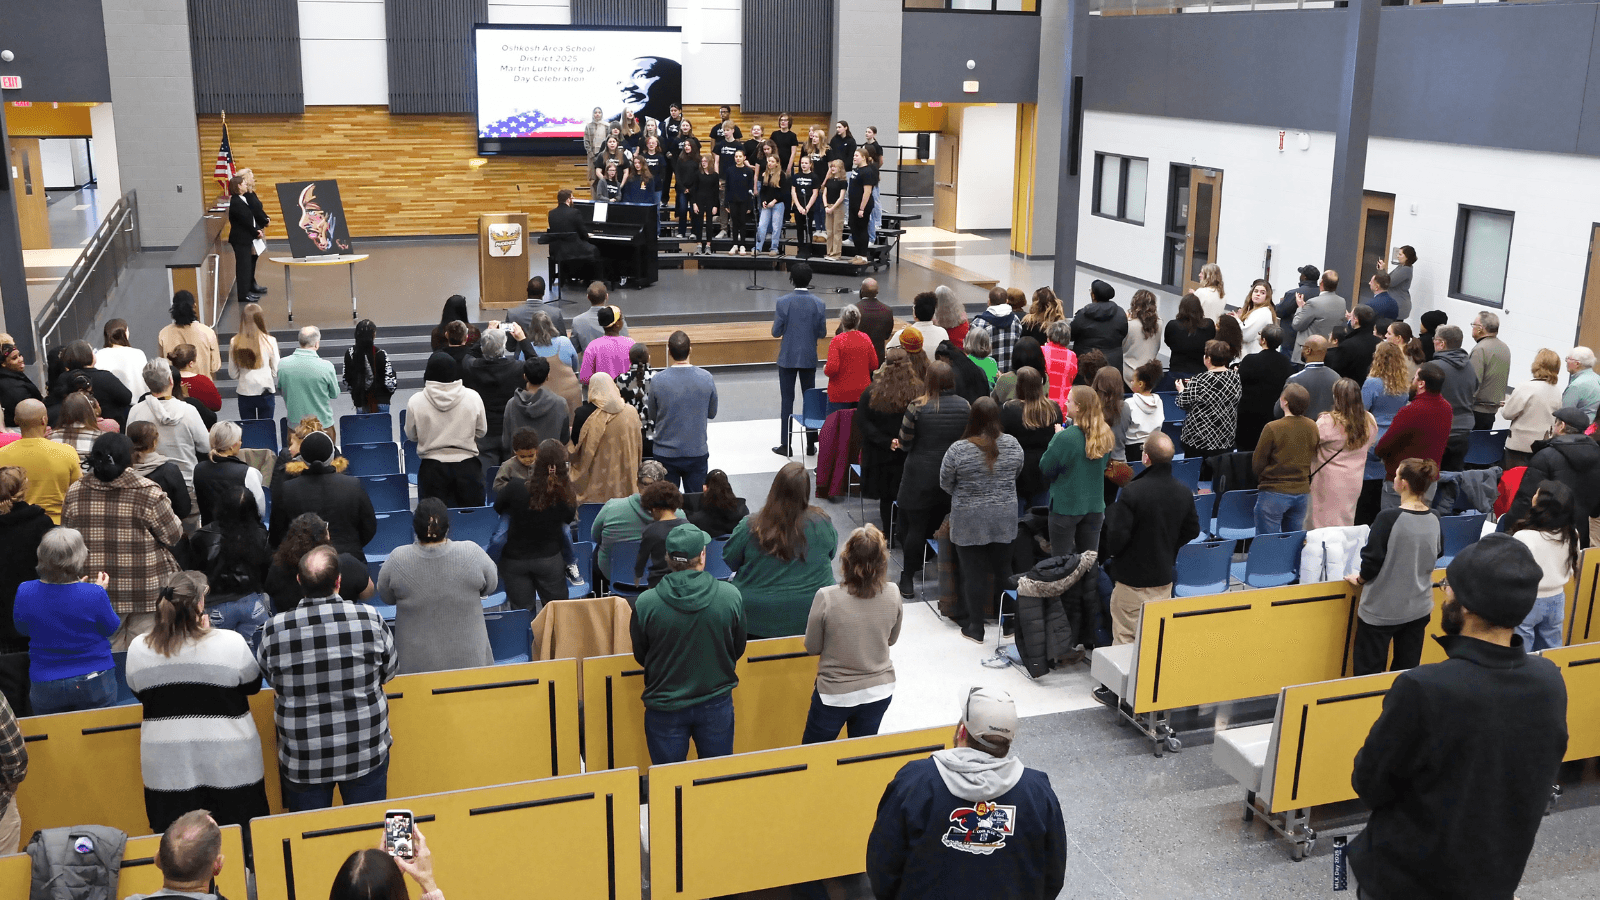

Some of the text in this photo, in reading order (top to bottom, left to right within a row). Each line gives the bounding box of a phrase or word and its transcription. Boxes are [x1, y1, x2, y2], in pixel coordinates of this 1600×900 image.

[564, 65, 584, 74] King
[3, 77, 18, 87] EXIT
[513, 75, 531, 84] Day
